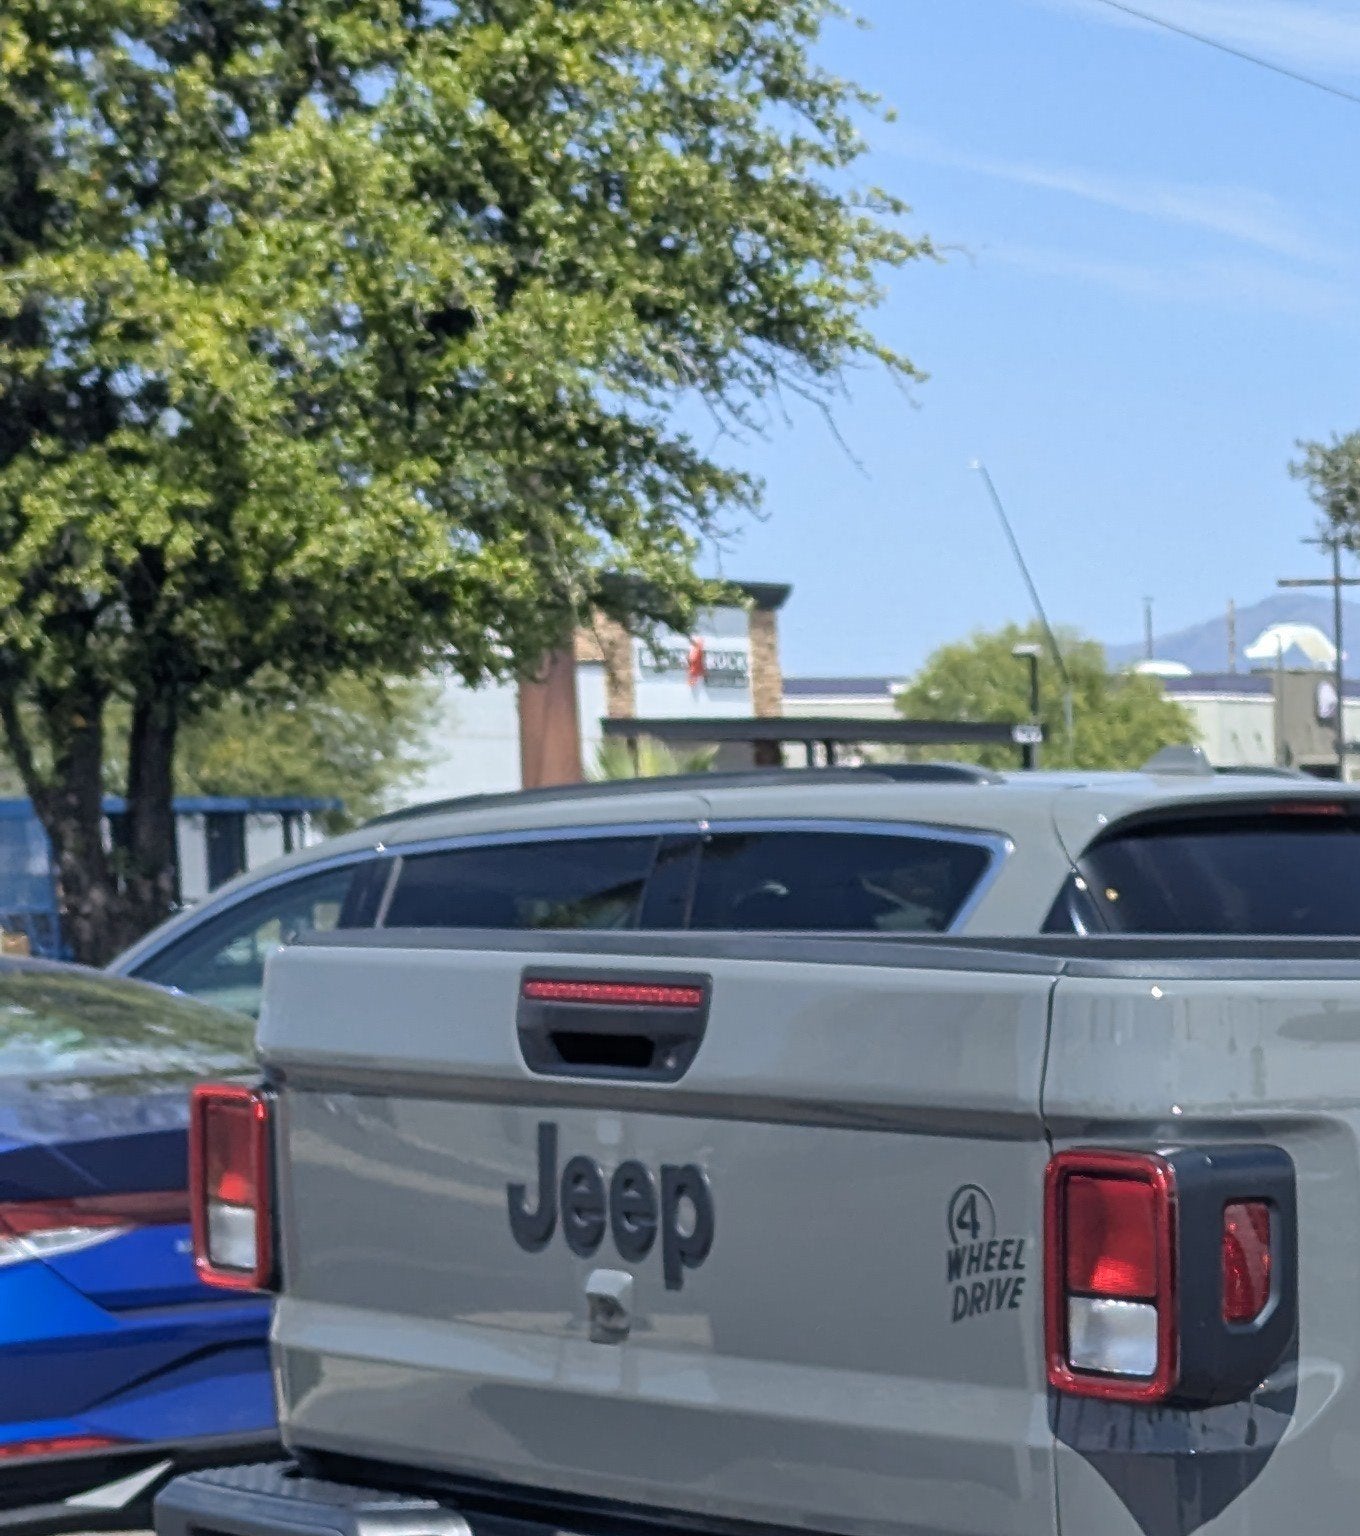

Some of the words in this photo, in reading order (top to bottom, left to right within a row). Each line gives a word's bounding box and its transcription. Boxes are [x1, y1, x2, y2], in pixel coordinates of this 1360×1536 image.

[507, 1120, 715, 1290] Jeep
[947, 1238, 1026, 1282] WHEEL
[953, 1276, 1026, 1322] DRIVE
